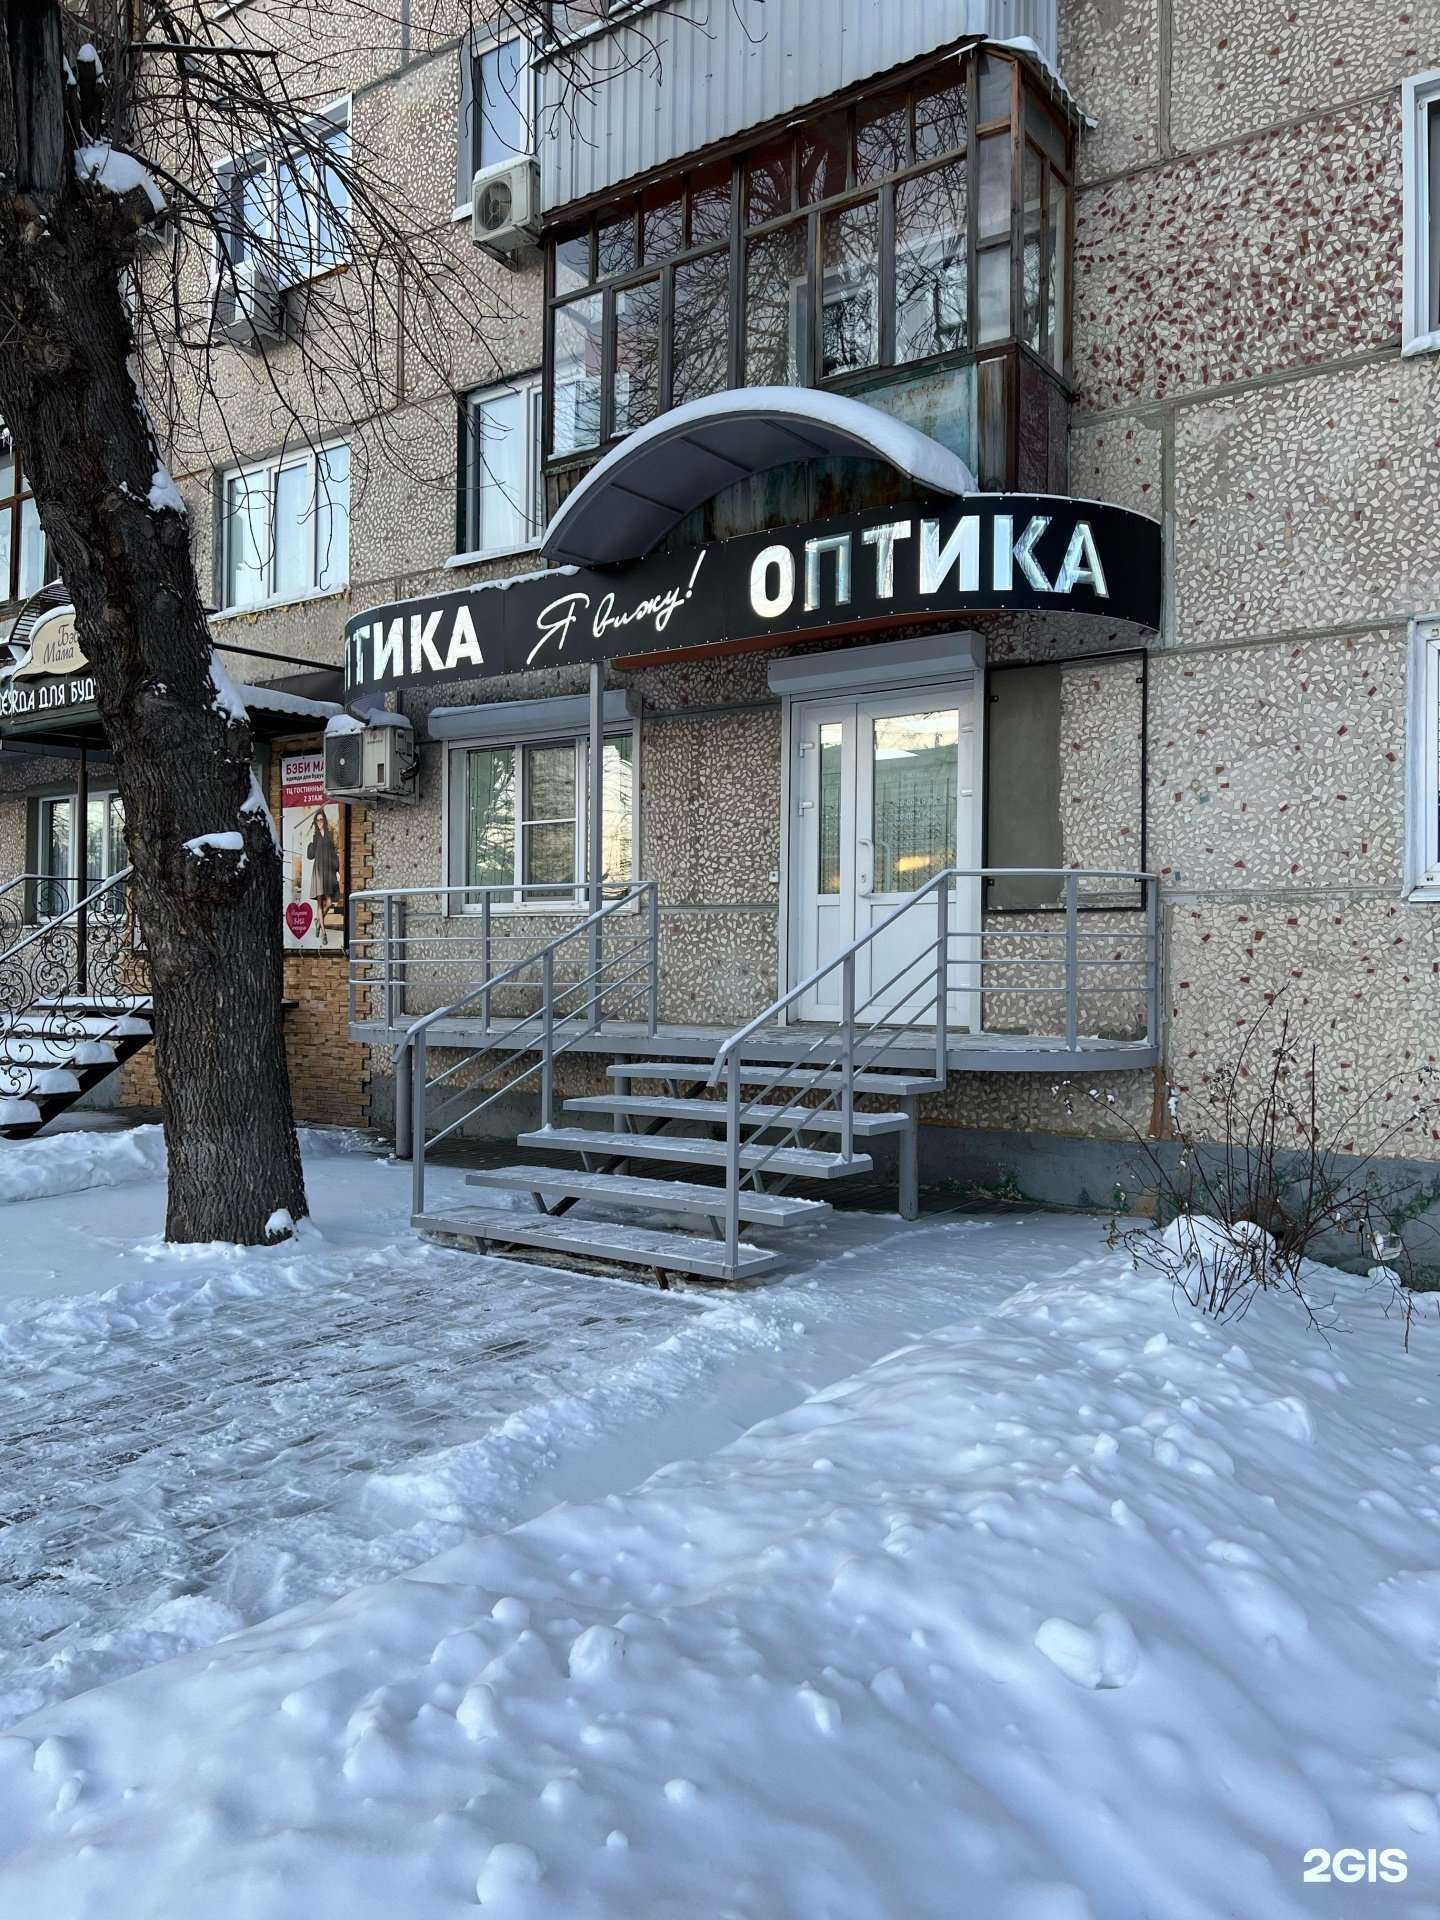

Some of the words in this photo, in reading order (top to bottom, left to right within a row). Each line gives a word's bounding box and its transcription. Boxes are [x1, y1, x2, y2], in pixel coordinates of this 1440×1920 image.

[750, 515, 1109, 618] ОПТИКА
[526, 592, 590, 665] Я
[592, 549, 706, 638] вижу!
[38, 683, 65, 709] ДЛЯ
[71, 678, 97, 703] БУД
[286, 762, 310, 775] БЭБИ
